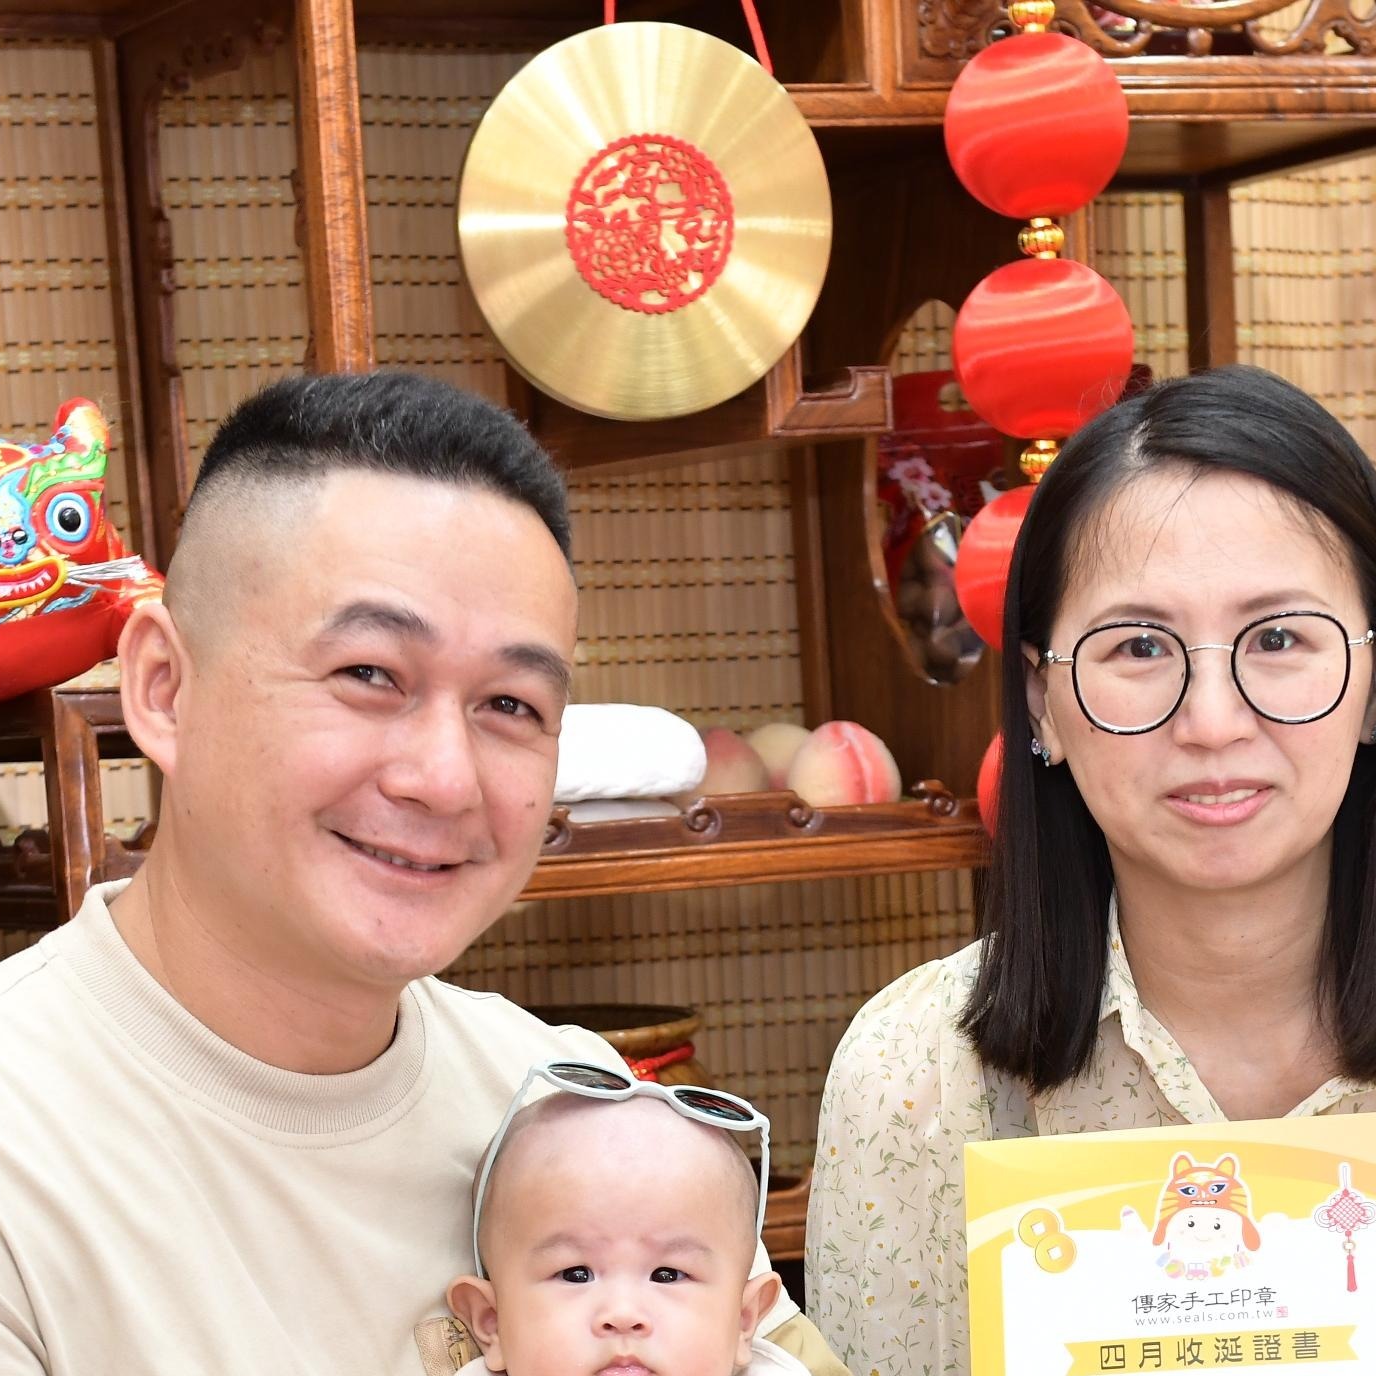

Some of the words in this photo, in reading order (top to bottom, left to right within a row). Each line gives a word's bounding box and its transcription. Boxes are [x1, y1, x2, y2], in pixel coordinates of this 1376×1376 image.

[1131, 1286, 1277, 1314] 傳家手工印章
[1135, 1309, 1274, 1326] www.seals.com.tw
[1100, 1331, 1321, 1370] 四月收涎證書
